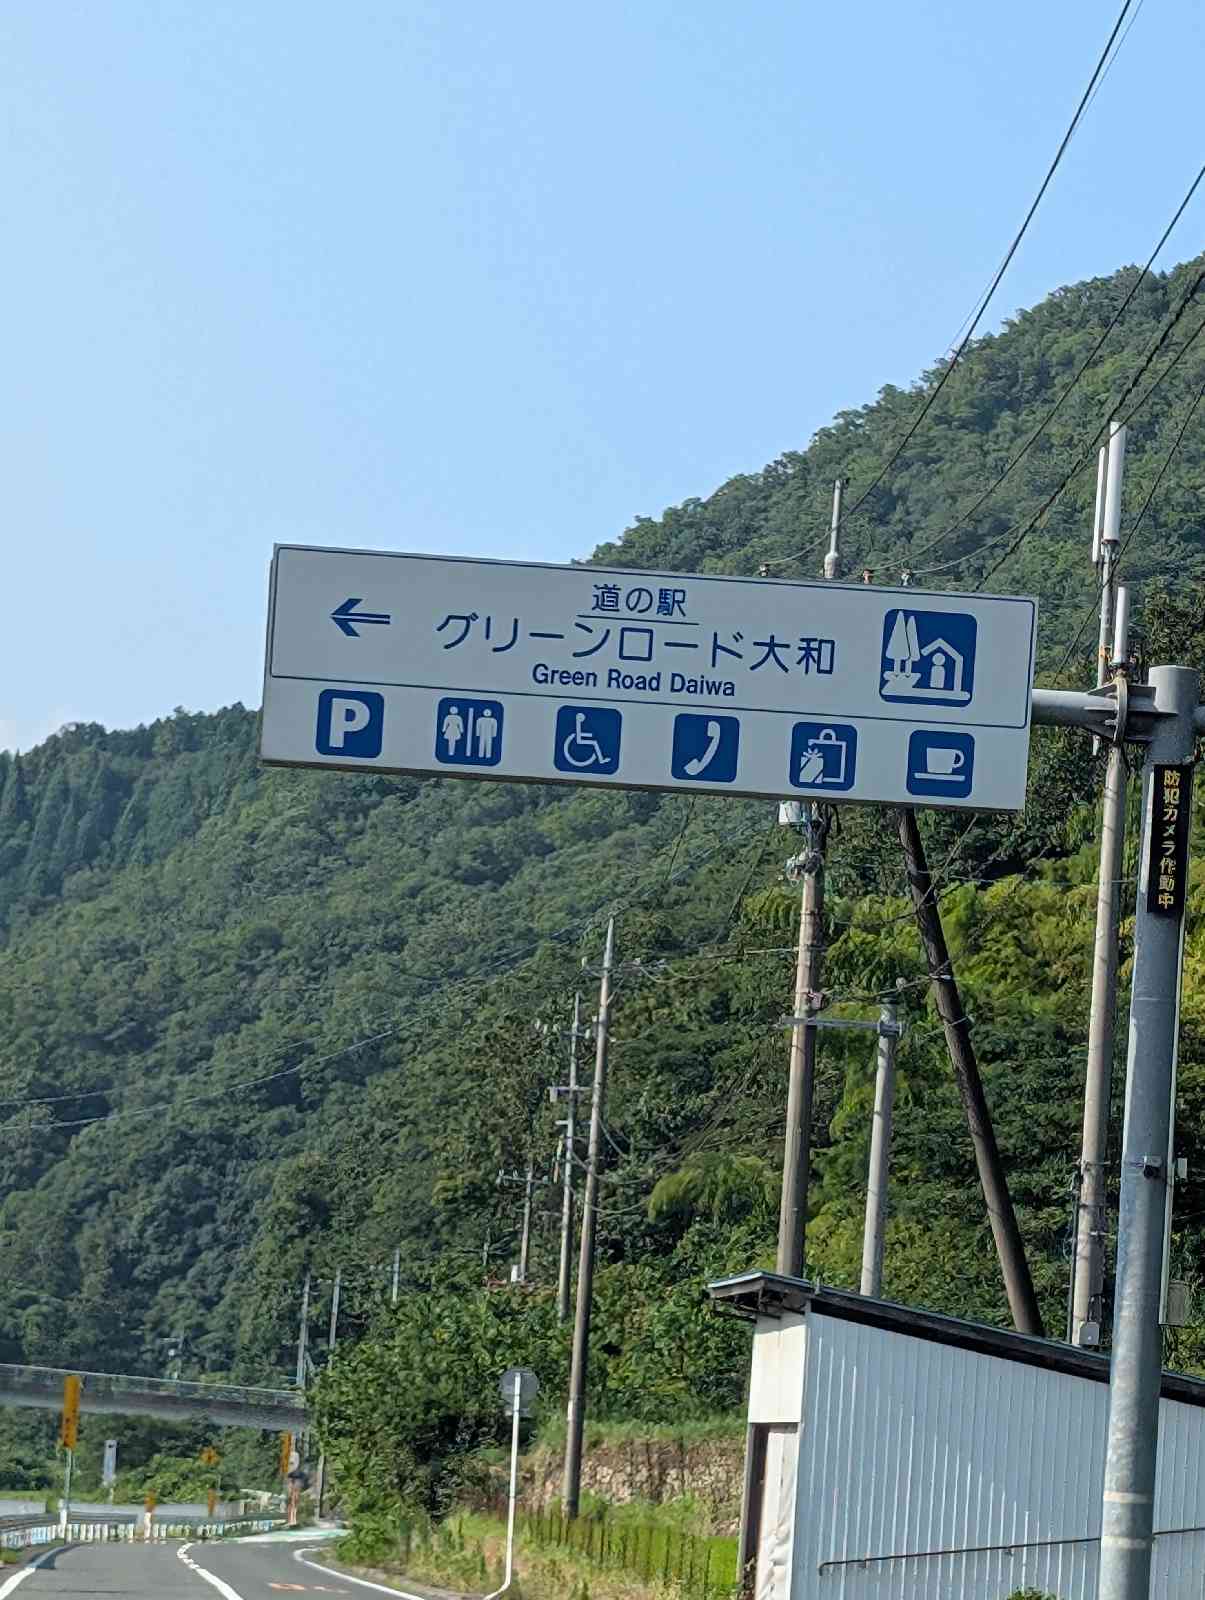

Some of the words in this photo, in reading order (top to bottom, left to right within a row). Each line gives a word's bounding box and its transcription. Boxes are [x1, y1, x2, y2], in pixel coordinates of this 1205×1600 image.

[592, 584, 686, 617] 道の駅
[435, 612, 836, 676] グリーンロード大和
[532, 663, 598, 688] Green
[607, 668, 662, 692] Road
[670, 672, 736, 697] Daiwa
[329, 697, 371, 748] P
[1157, 769, 1182, 911] 防犯カメラ作動中
